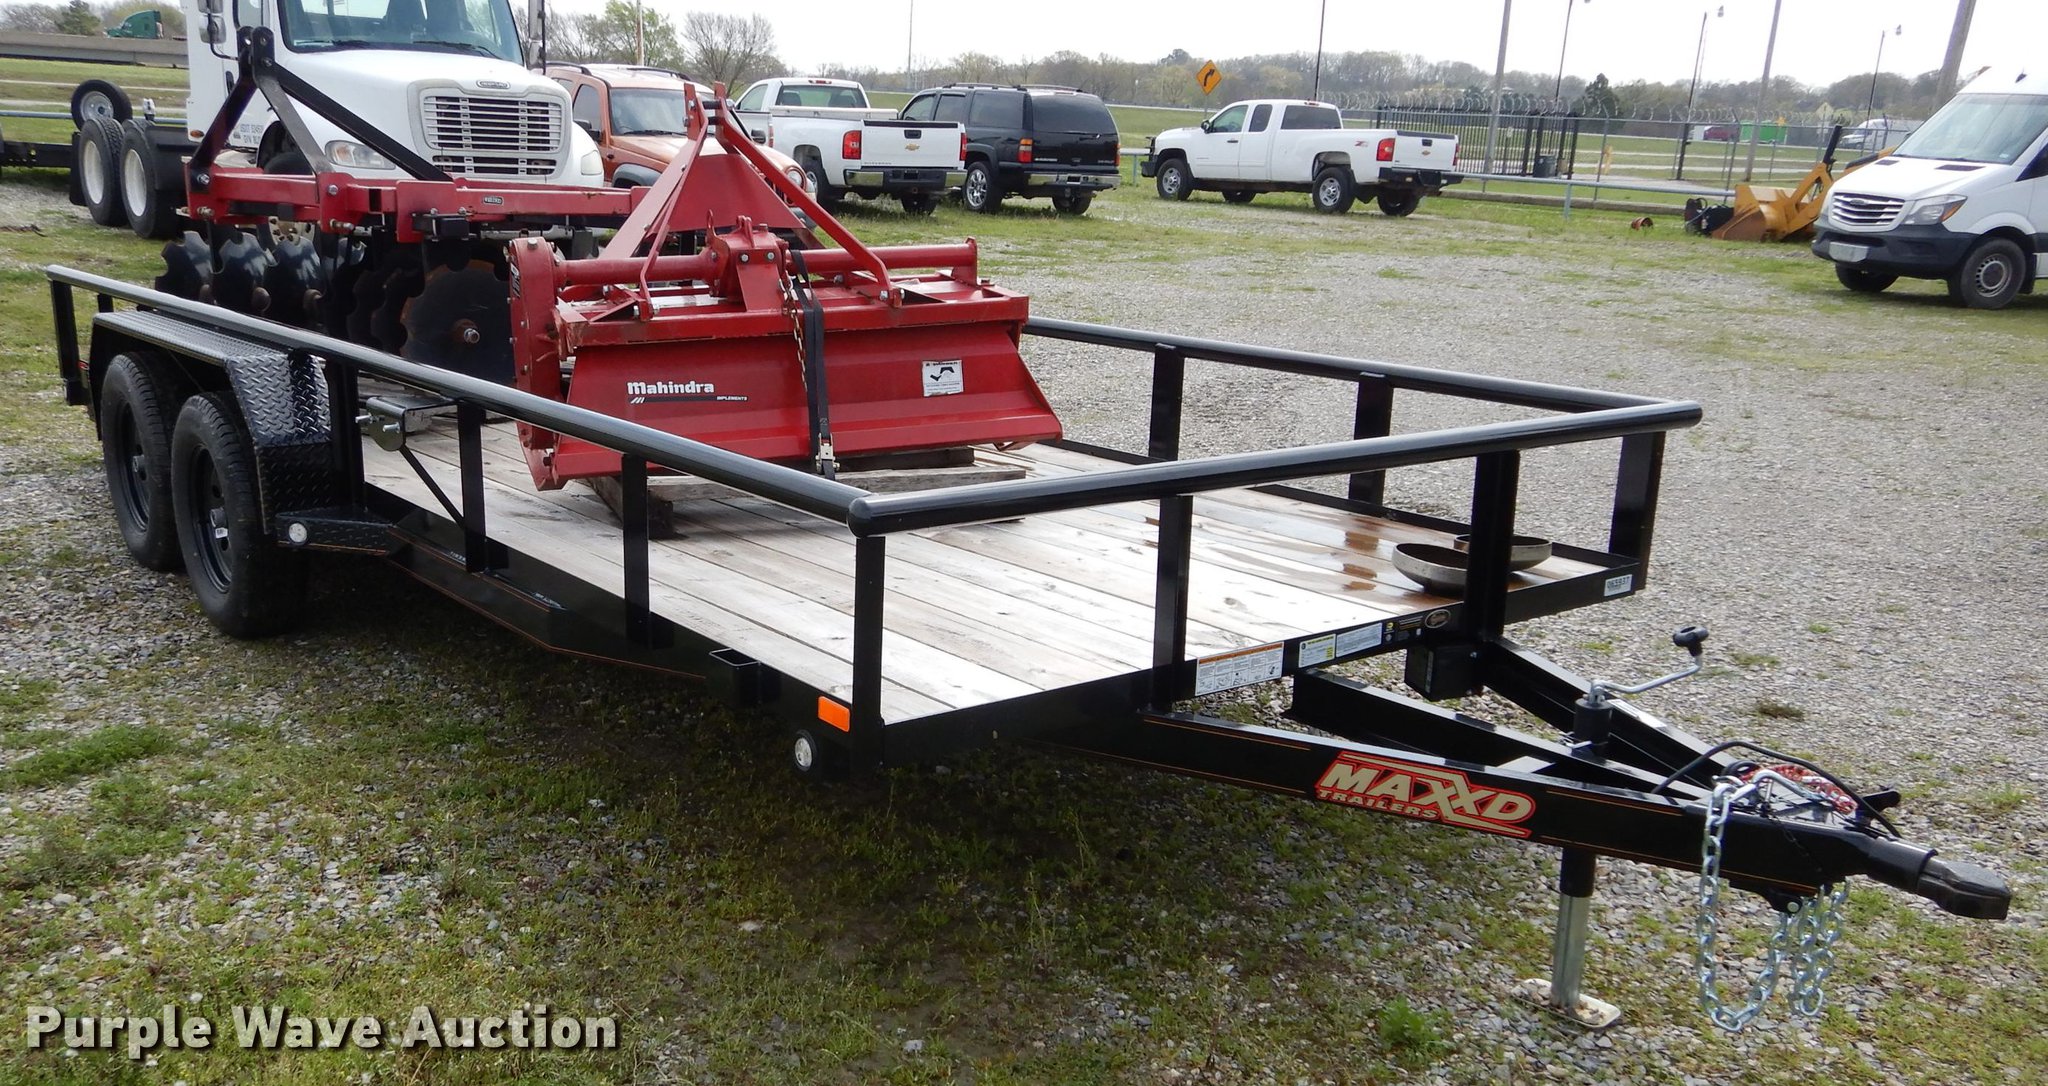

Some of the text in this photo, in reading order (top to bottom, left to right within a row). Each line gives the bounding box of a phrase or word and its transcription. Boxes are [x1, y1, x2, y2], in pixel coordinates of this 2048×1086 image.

[627, 381, 715, 395] Mahindra
[1317, 756, 1535, 831] MAXXD
[1319, 790, 1439, 818] TRAILERS
